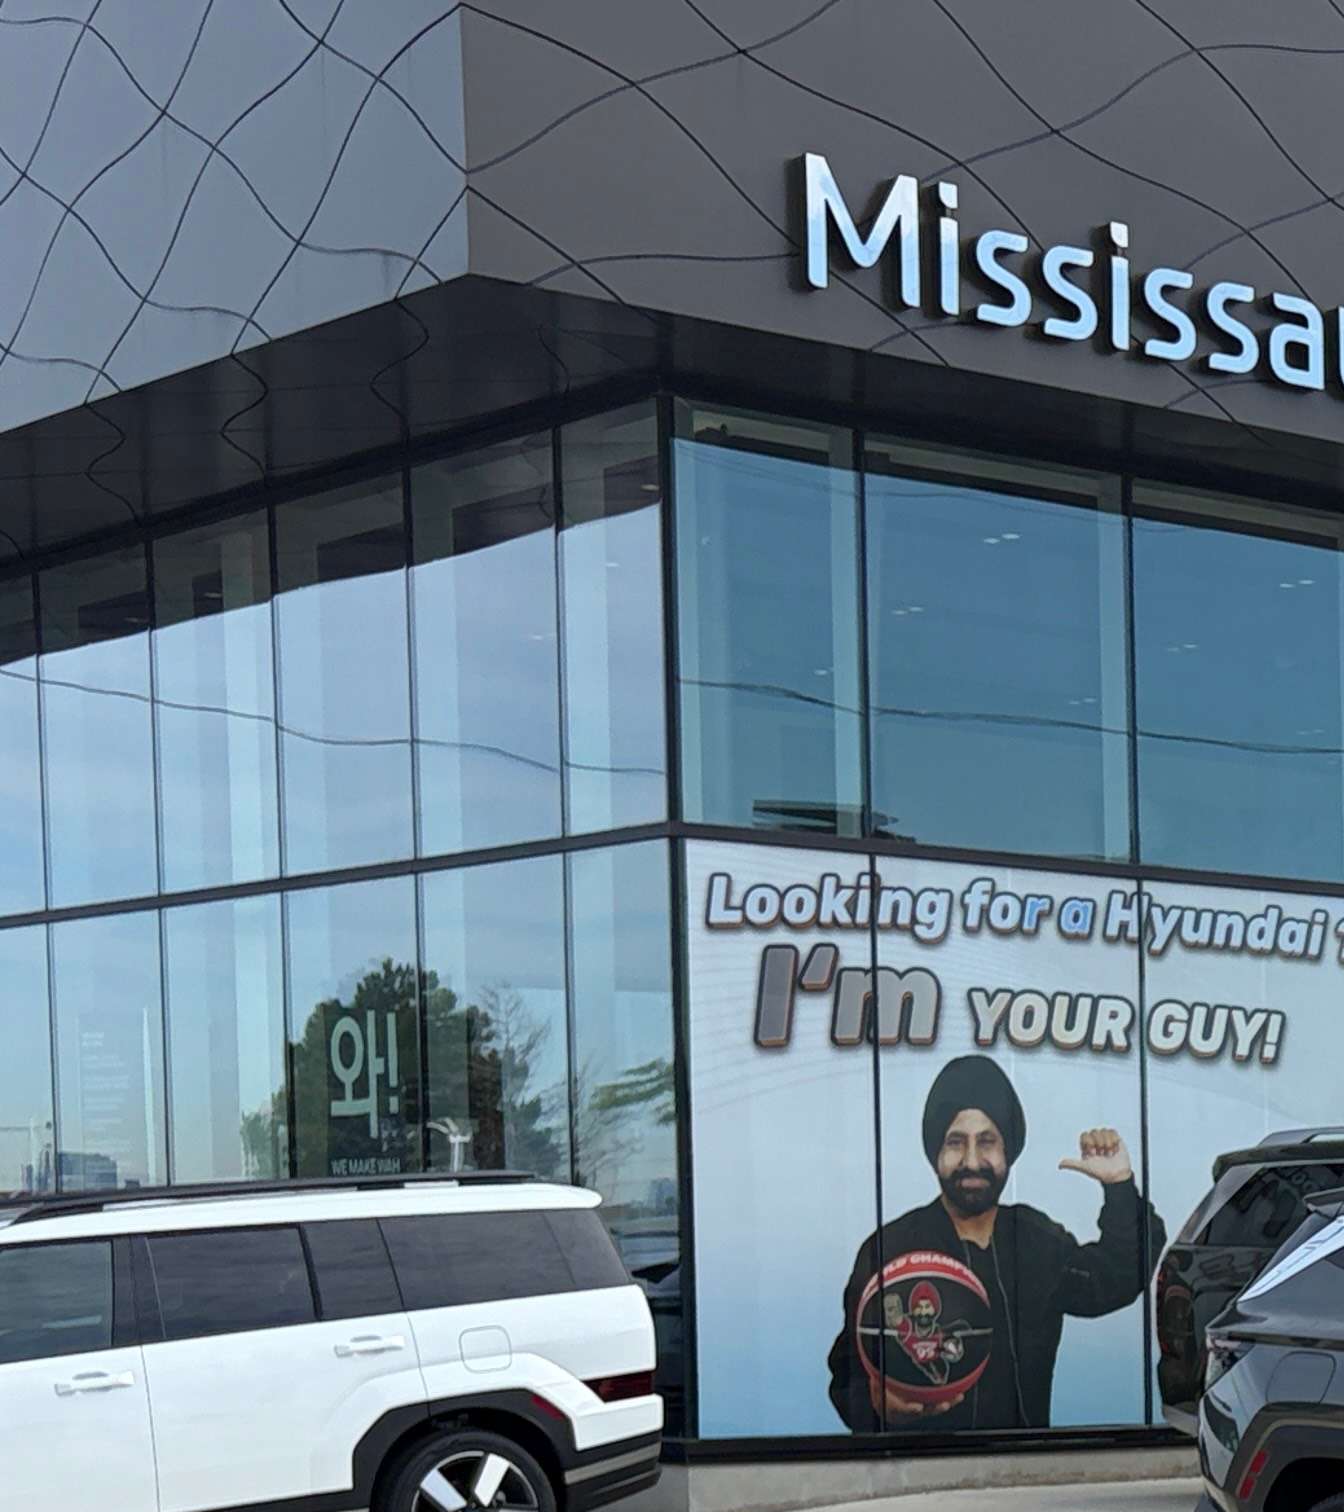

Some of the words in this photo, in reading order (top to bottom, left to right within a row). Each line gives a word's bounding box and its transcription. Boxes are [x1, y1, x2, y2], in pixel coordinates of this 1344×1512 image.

[705, 871, 952, 945] Looking
[963, 877, 1051, 935] for
[1058, 896, 1096, 940] a
[754, 942, 943, 1048] I'm
[967, 986, 1136, 1051] YOUR
[1147, 998, 1287, 1064] GUY!
[331, 1158, 348, 1176] WE
[348, 1158, 377, 1174] MAKE
